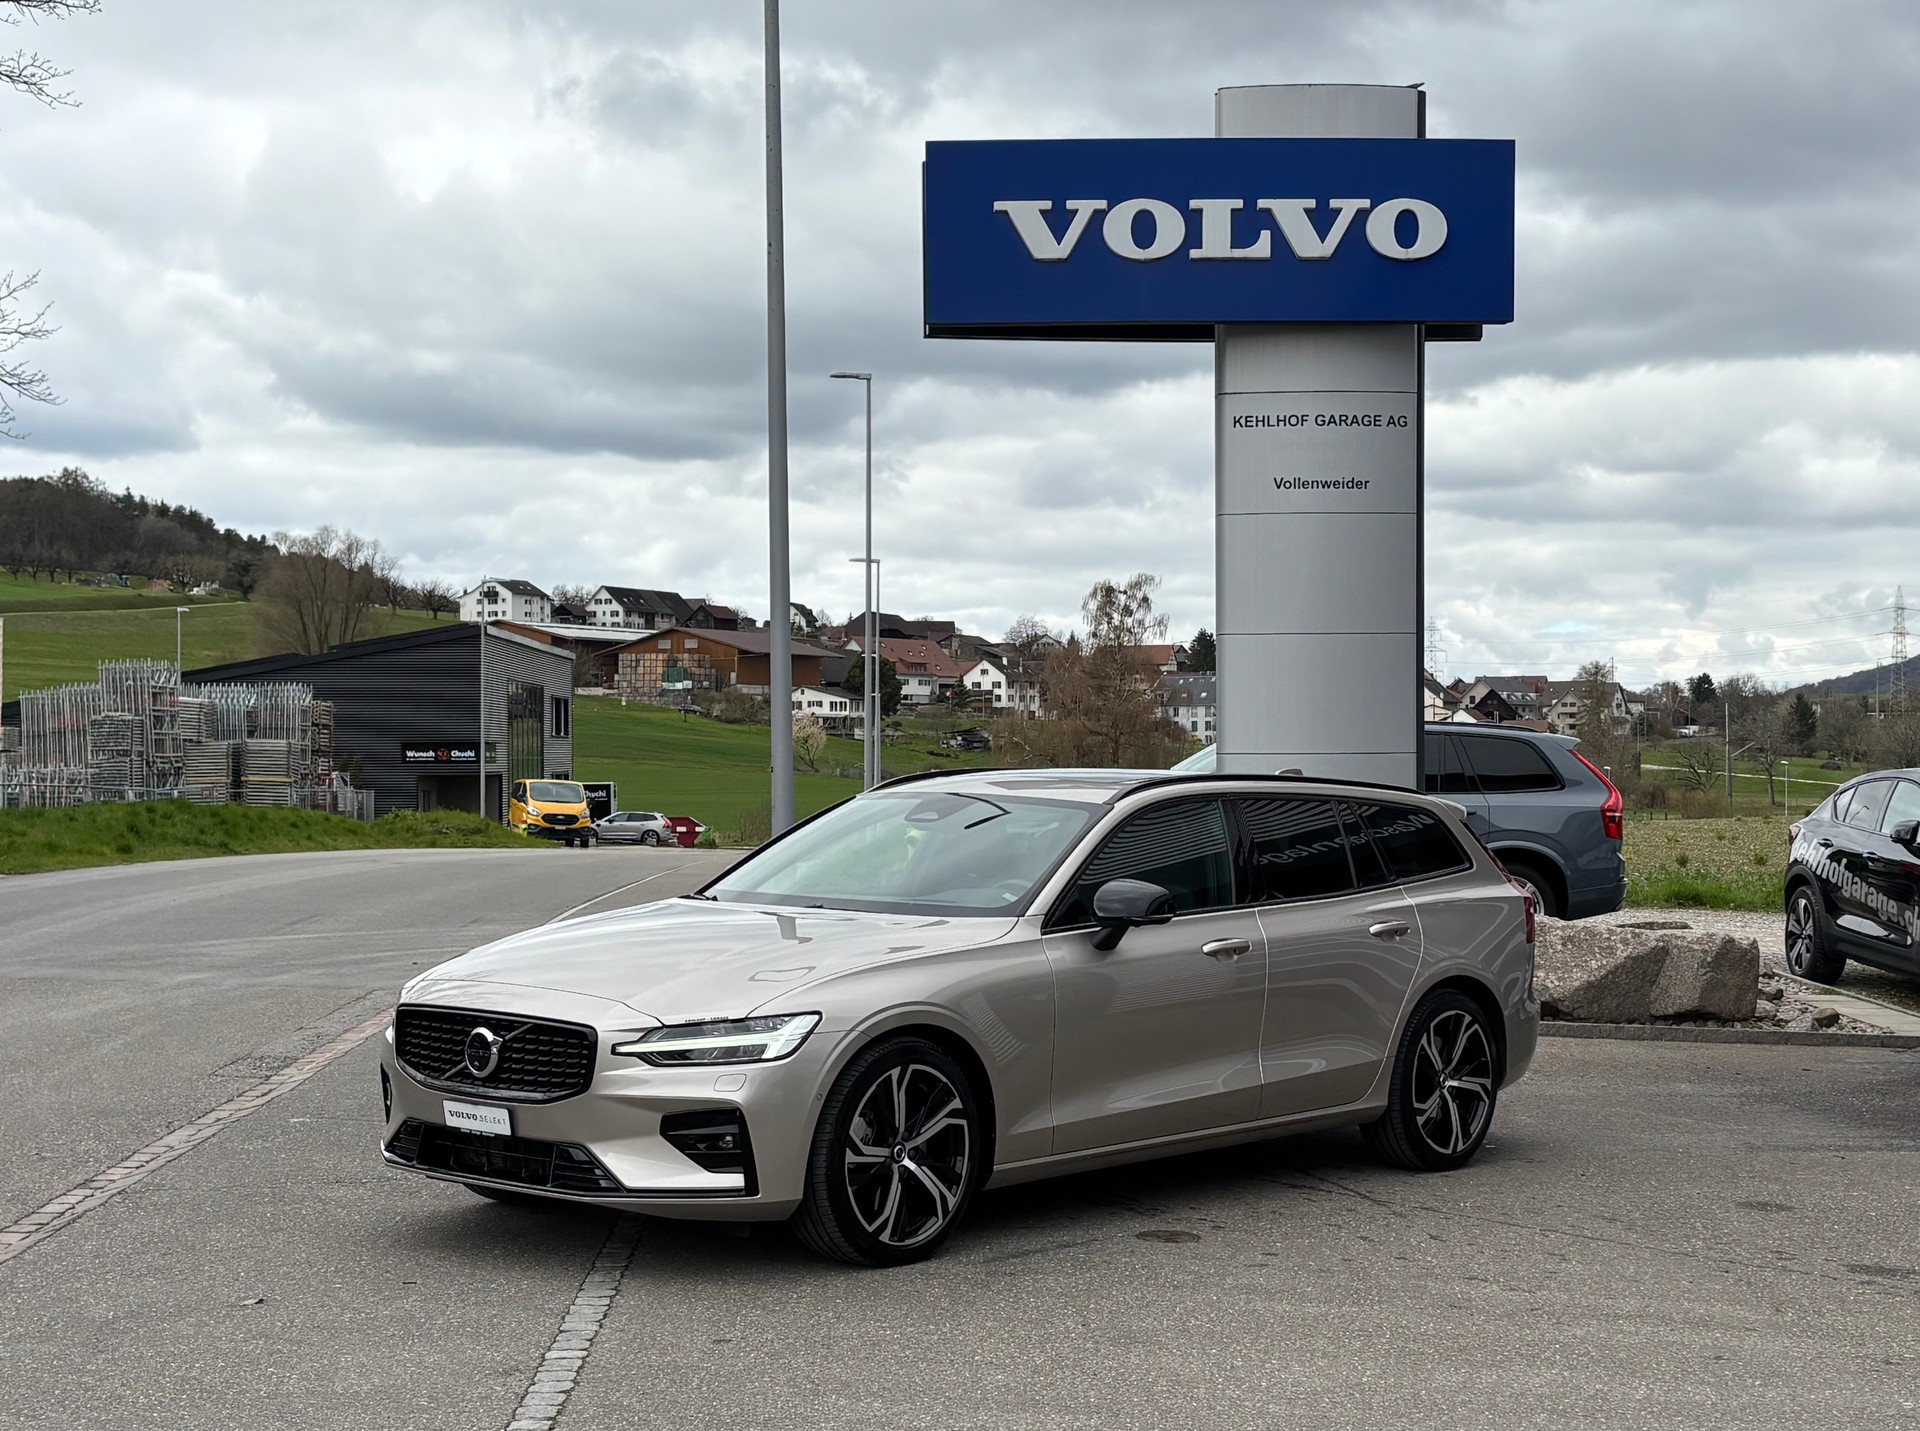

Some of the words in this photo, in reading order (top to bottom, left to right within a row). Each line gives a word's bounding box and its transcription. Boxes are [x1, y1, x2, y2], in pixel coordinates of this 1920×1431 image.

[993, 198, 1448, 261] VOLVO
[1233, 415, 1309, 428] KEHLHOF
[1314, 414, 1382, 427] GARAGE
[1386, 415, 1408, 428] AG
[1273, 477, 1370, 490] Vollenweider
[406, 749, 435, 757] Wunsch
[448, 1110, 478, 1121] VOLVO
[479, 1114, 506, 1126] SELEKT
